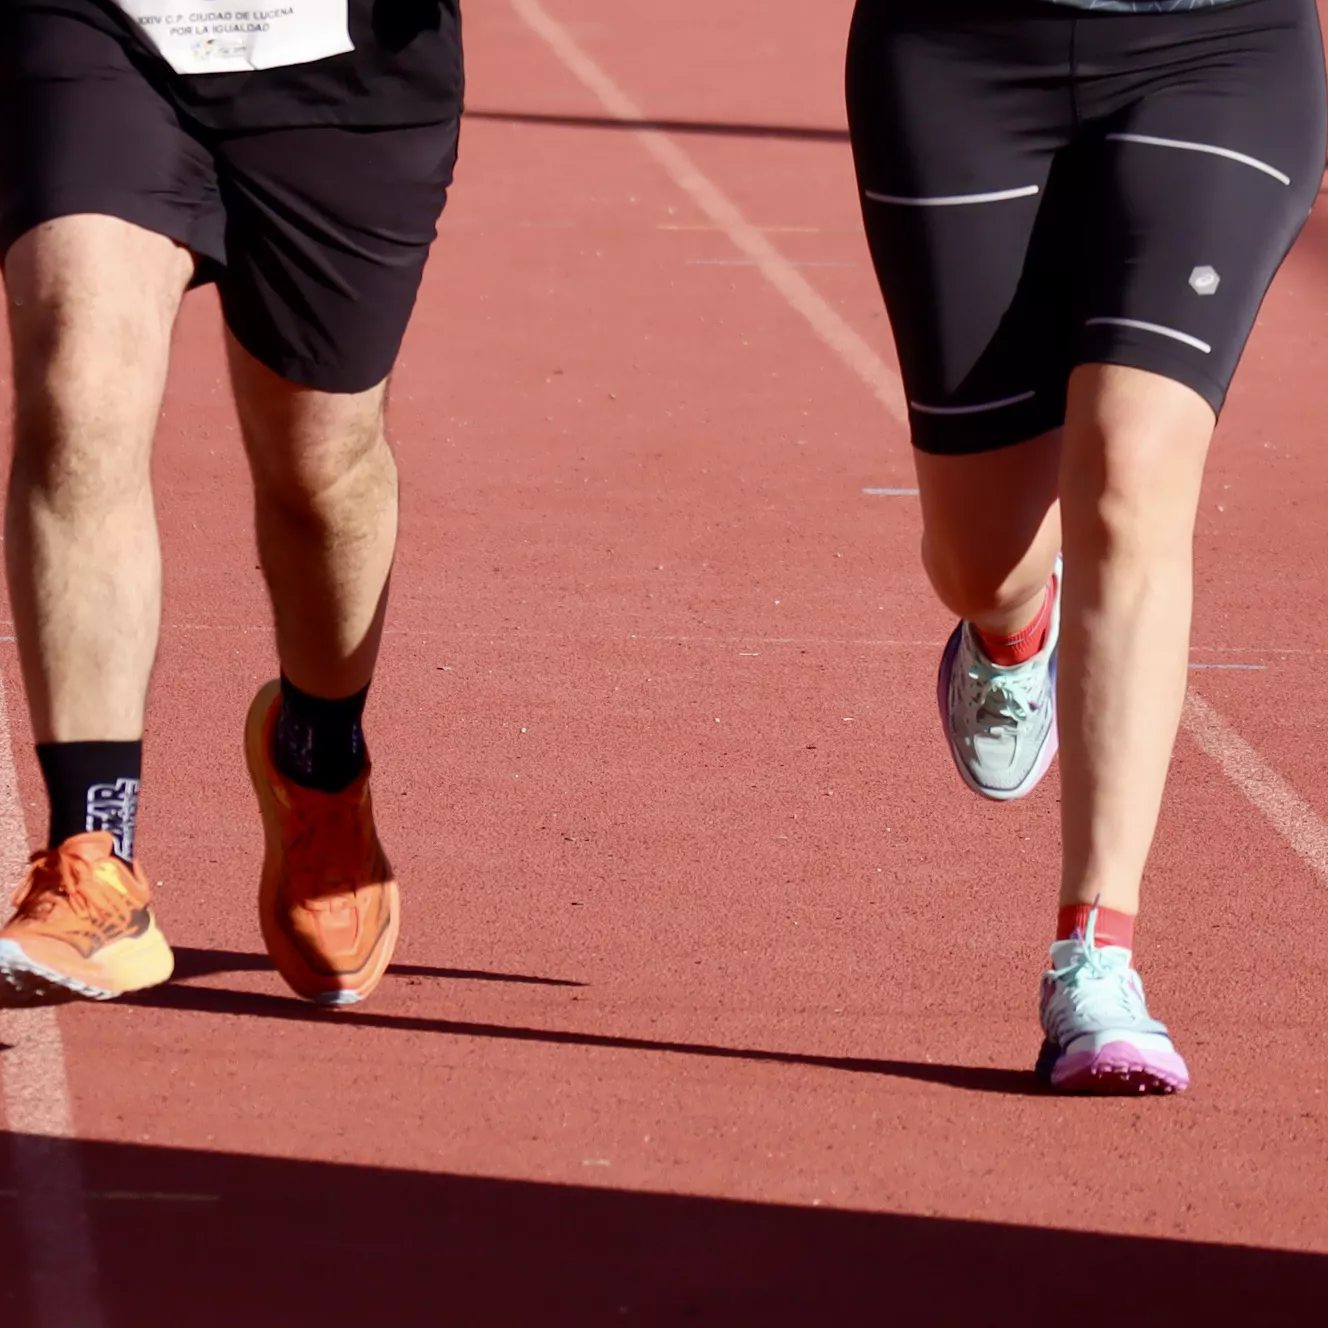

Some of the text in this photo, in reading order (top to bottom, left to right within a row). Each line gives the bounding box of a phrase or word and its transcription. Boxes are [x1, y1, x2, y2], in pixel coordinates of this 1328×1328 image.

[189, 11, 233, 23] CIUDAD
[235, 11, 251, 22] DE
[252, 6, 294, 21] LUCENA
[170, 22, 270, 37] POR LA IGUALDAD
